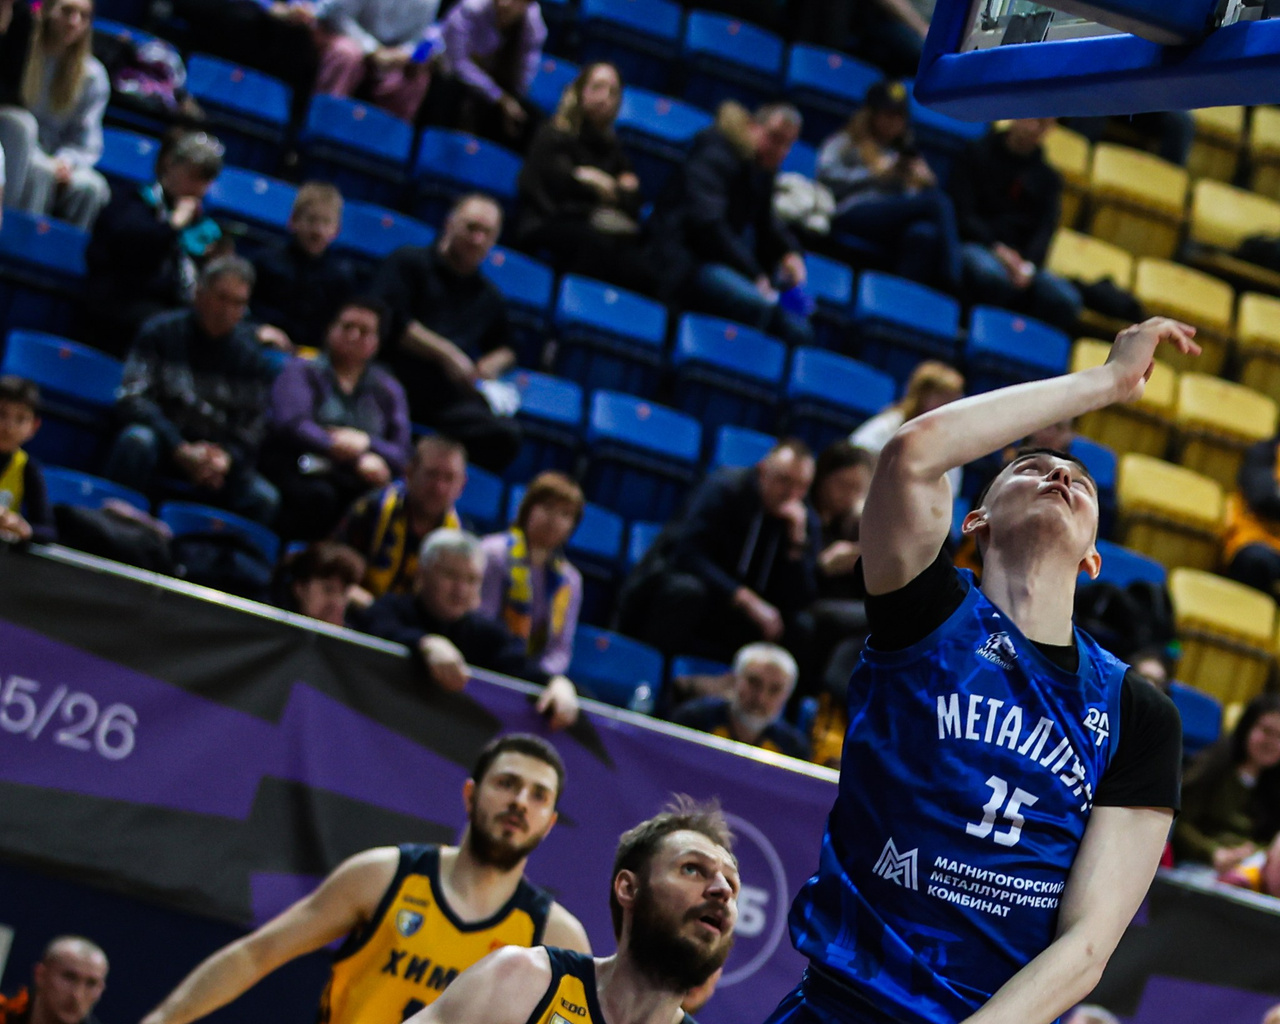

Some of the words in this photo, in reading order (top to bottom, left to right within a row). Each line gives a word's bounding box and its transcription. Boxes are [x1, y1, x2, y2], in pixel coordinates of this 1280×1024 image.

[0, 674, 138, 760] 5/26
[965, 775, 1039, 847] 35
[927, 885, 1011, 918] КОМБИНАТ
[381, 948, 459, 991] ХИМ
